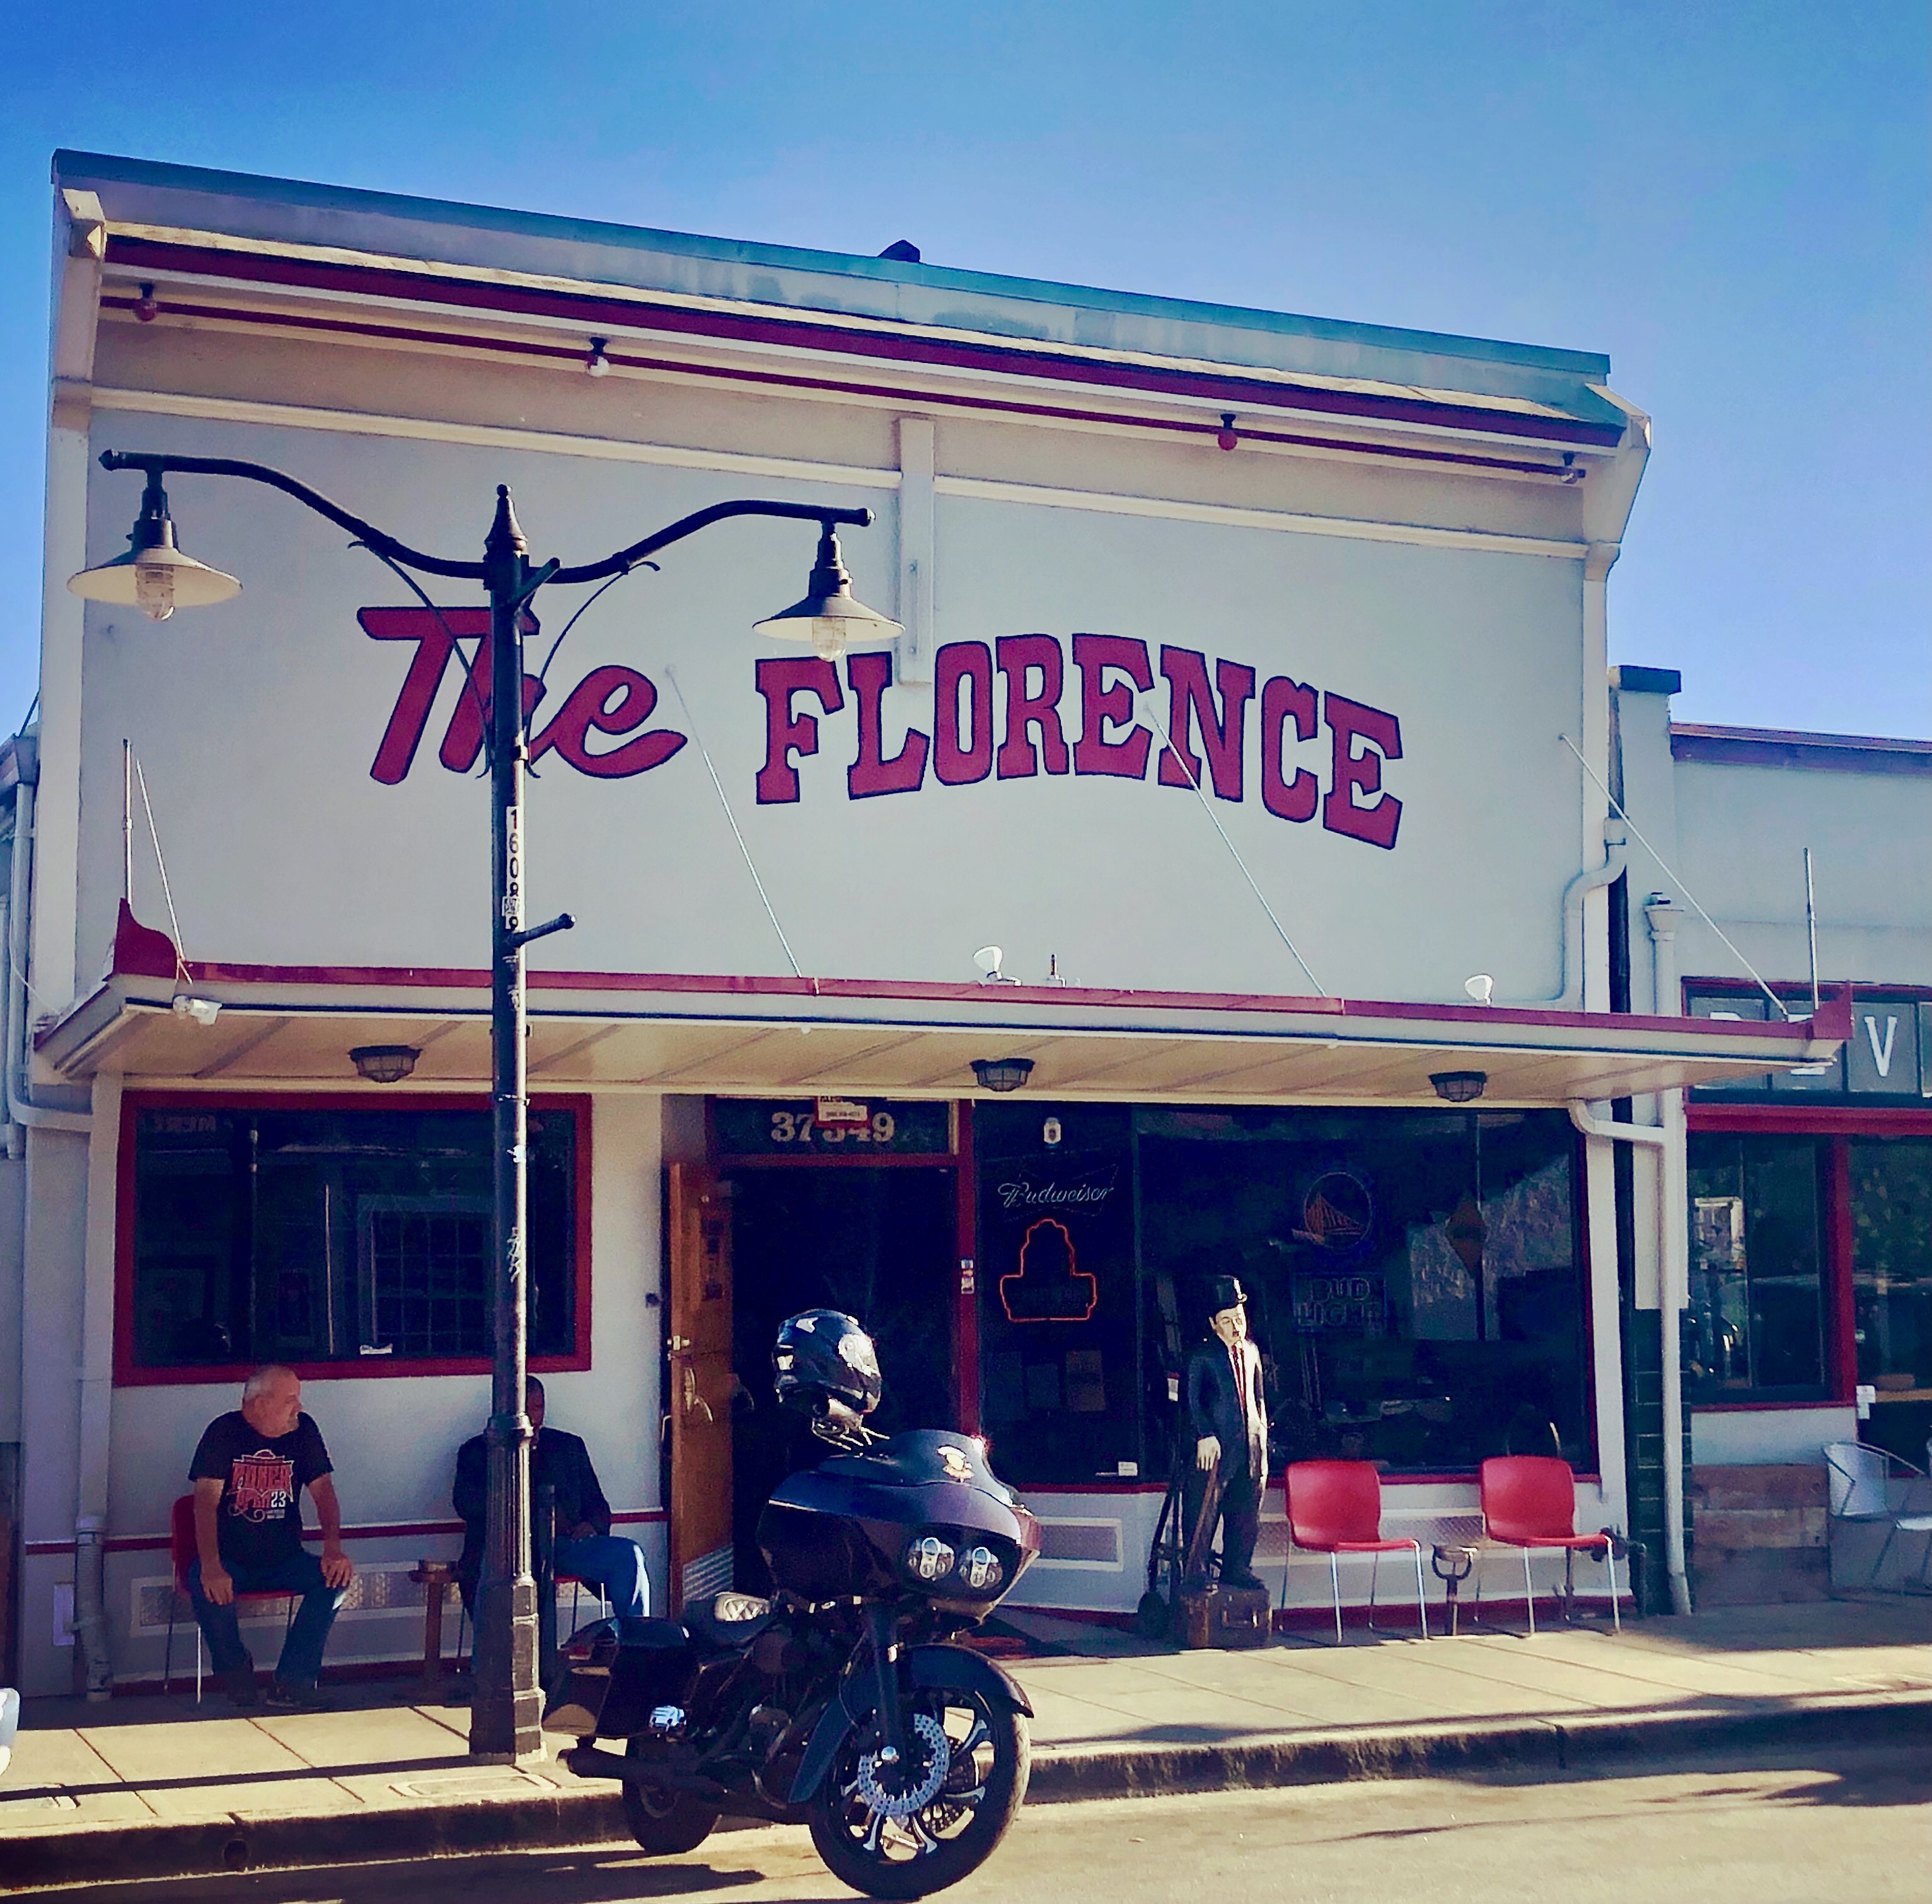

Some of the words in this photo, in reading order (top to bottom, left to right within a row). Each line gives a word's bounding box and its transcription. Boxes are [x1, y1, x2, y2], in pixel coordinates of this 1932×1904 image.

[356, 596, 688, 785] The
[755, 633, 1403, 850] FLORENCE
[998, 1182, 1114, 1208] Budweiser
[271, 1491, 287, 1508] 23
